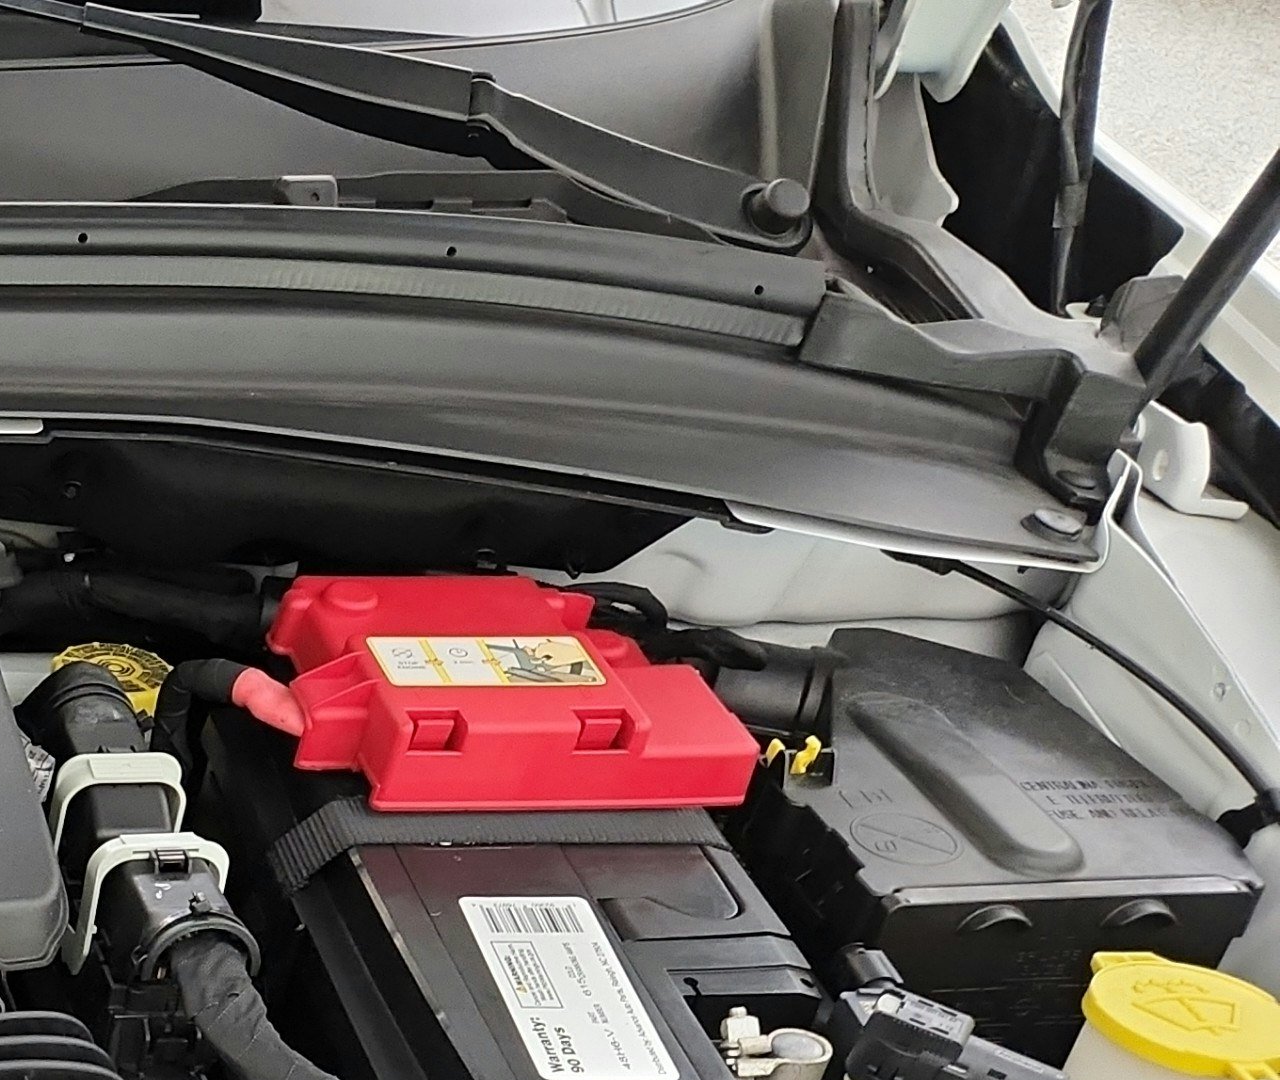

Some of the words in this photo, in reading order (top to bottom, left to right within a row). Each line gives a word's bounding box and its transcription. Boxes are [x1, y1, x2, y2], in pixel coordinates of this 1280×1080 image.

[530, 1016, 563, 1073] Warranty:
[552, 1026, 577, 1055] Days
[570, 1057, 585, 1074] 90
